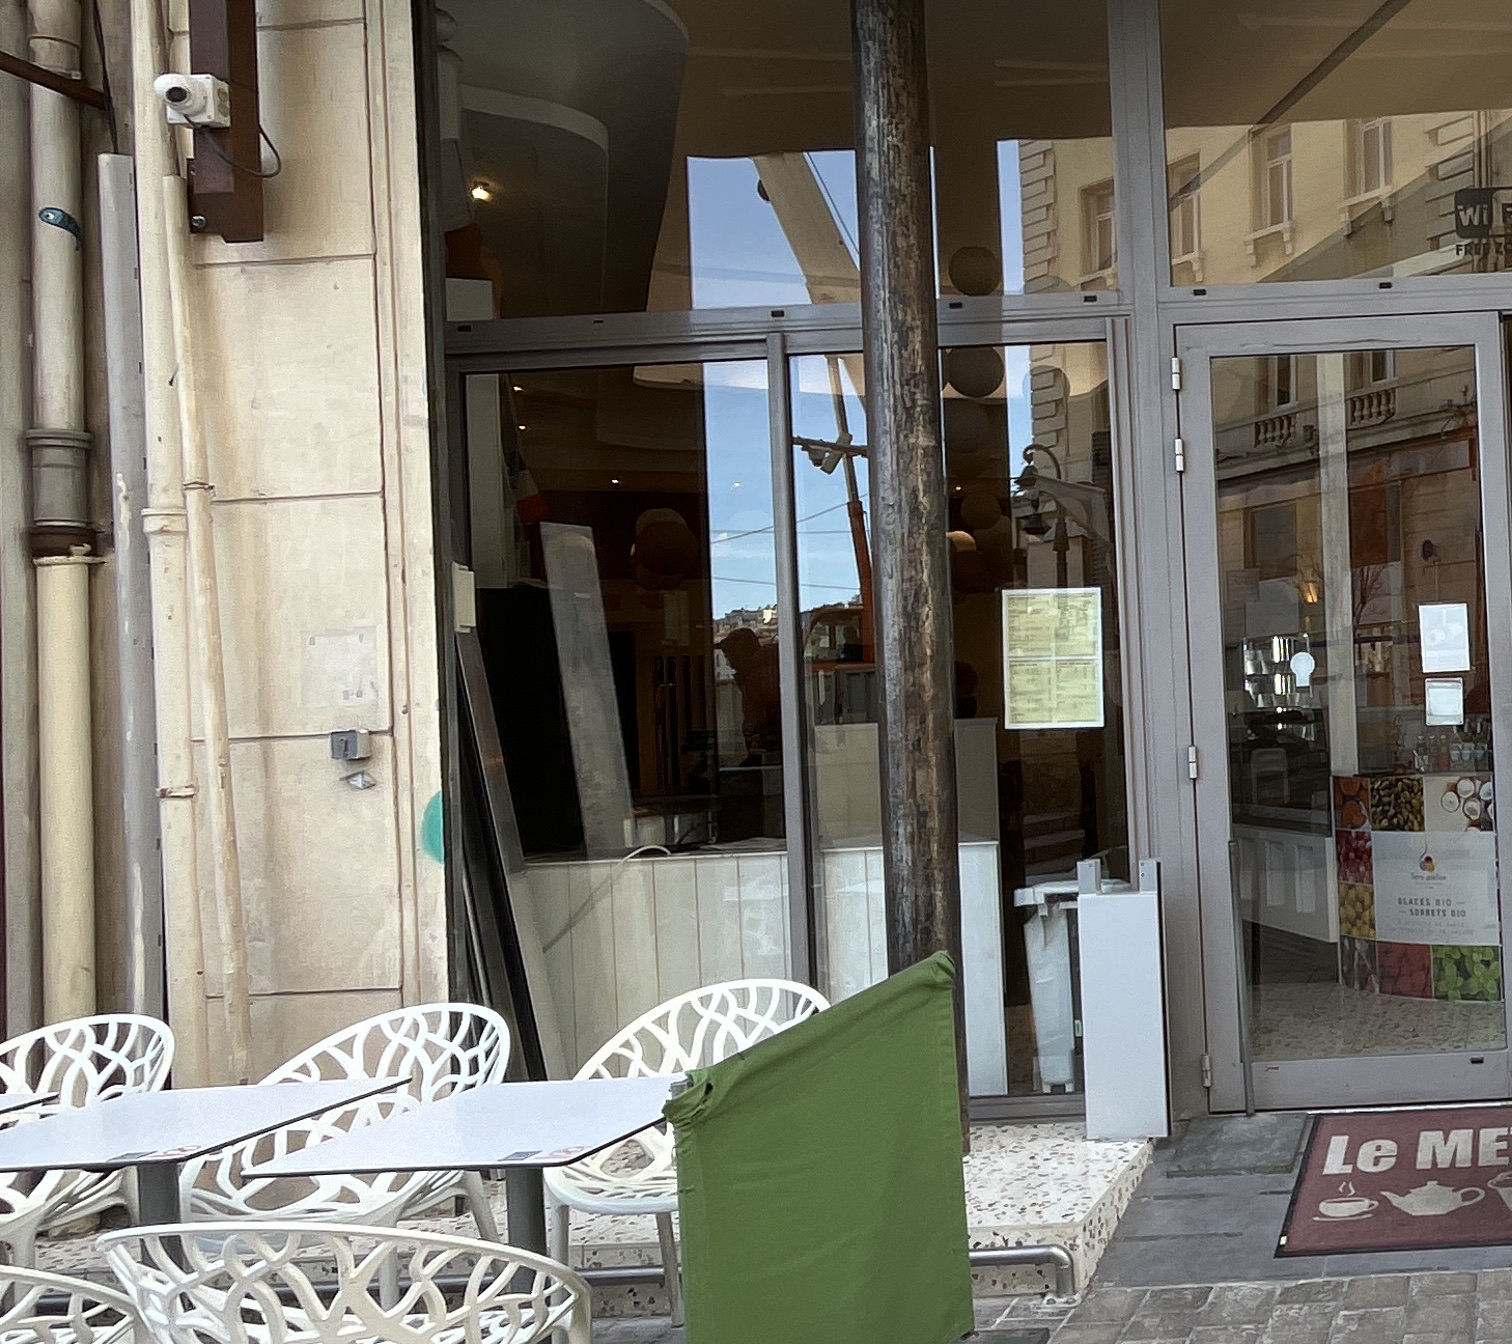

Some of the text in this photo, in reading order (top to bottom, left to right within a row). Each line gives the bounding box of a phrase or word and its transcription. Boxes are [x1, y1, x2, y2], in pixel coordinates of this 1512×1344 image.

[1456, 243, 1490, 256] FREE
[1435, 898, 1452, 907] BIO
[1321, 1135, 1398, 1175] Le
